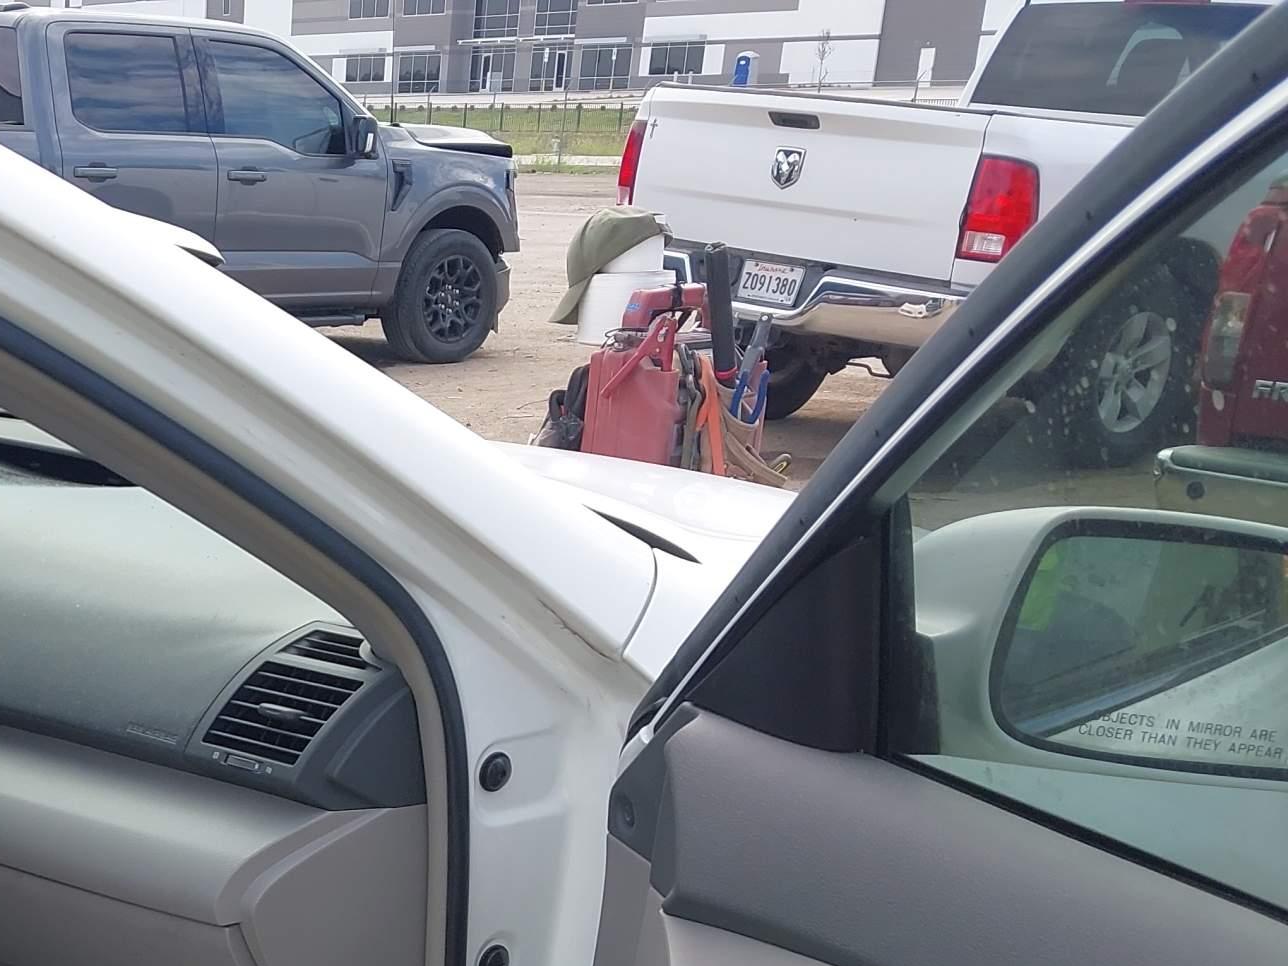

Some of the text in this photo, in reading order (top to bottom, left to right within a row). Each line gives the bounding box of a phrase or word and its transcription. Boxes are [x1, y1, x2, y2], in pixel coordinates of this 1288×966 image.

[742, 272, 797, 297] Z091380
[1078, 724, 1284, 760] CLOSER THAN THEY APPEAR
[1166, 718, 1181, 731] IN
[1188, 720, 1242, 738] MIRROR
[1249, 729, 1278, 743] ARE
